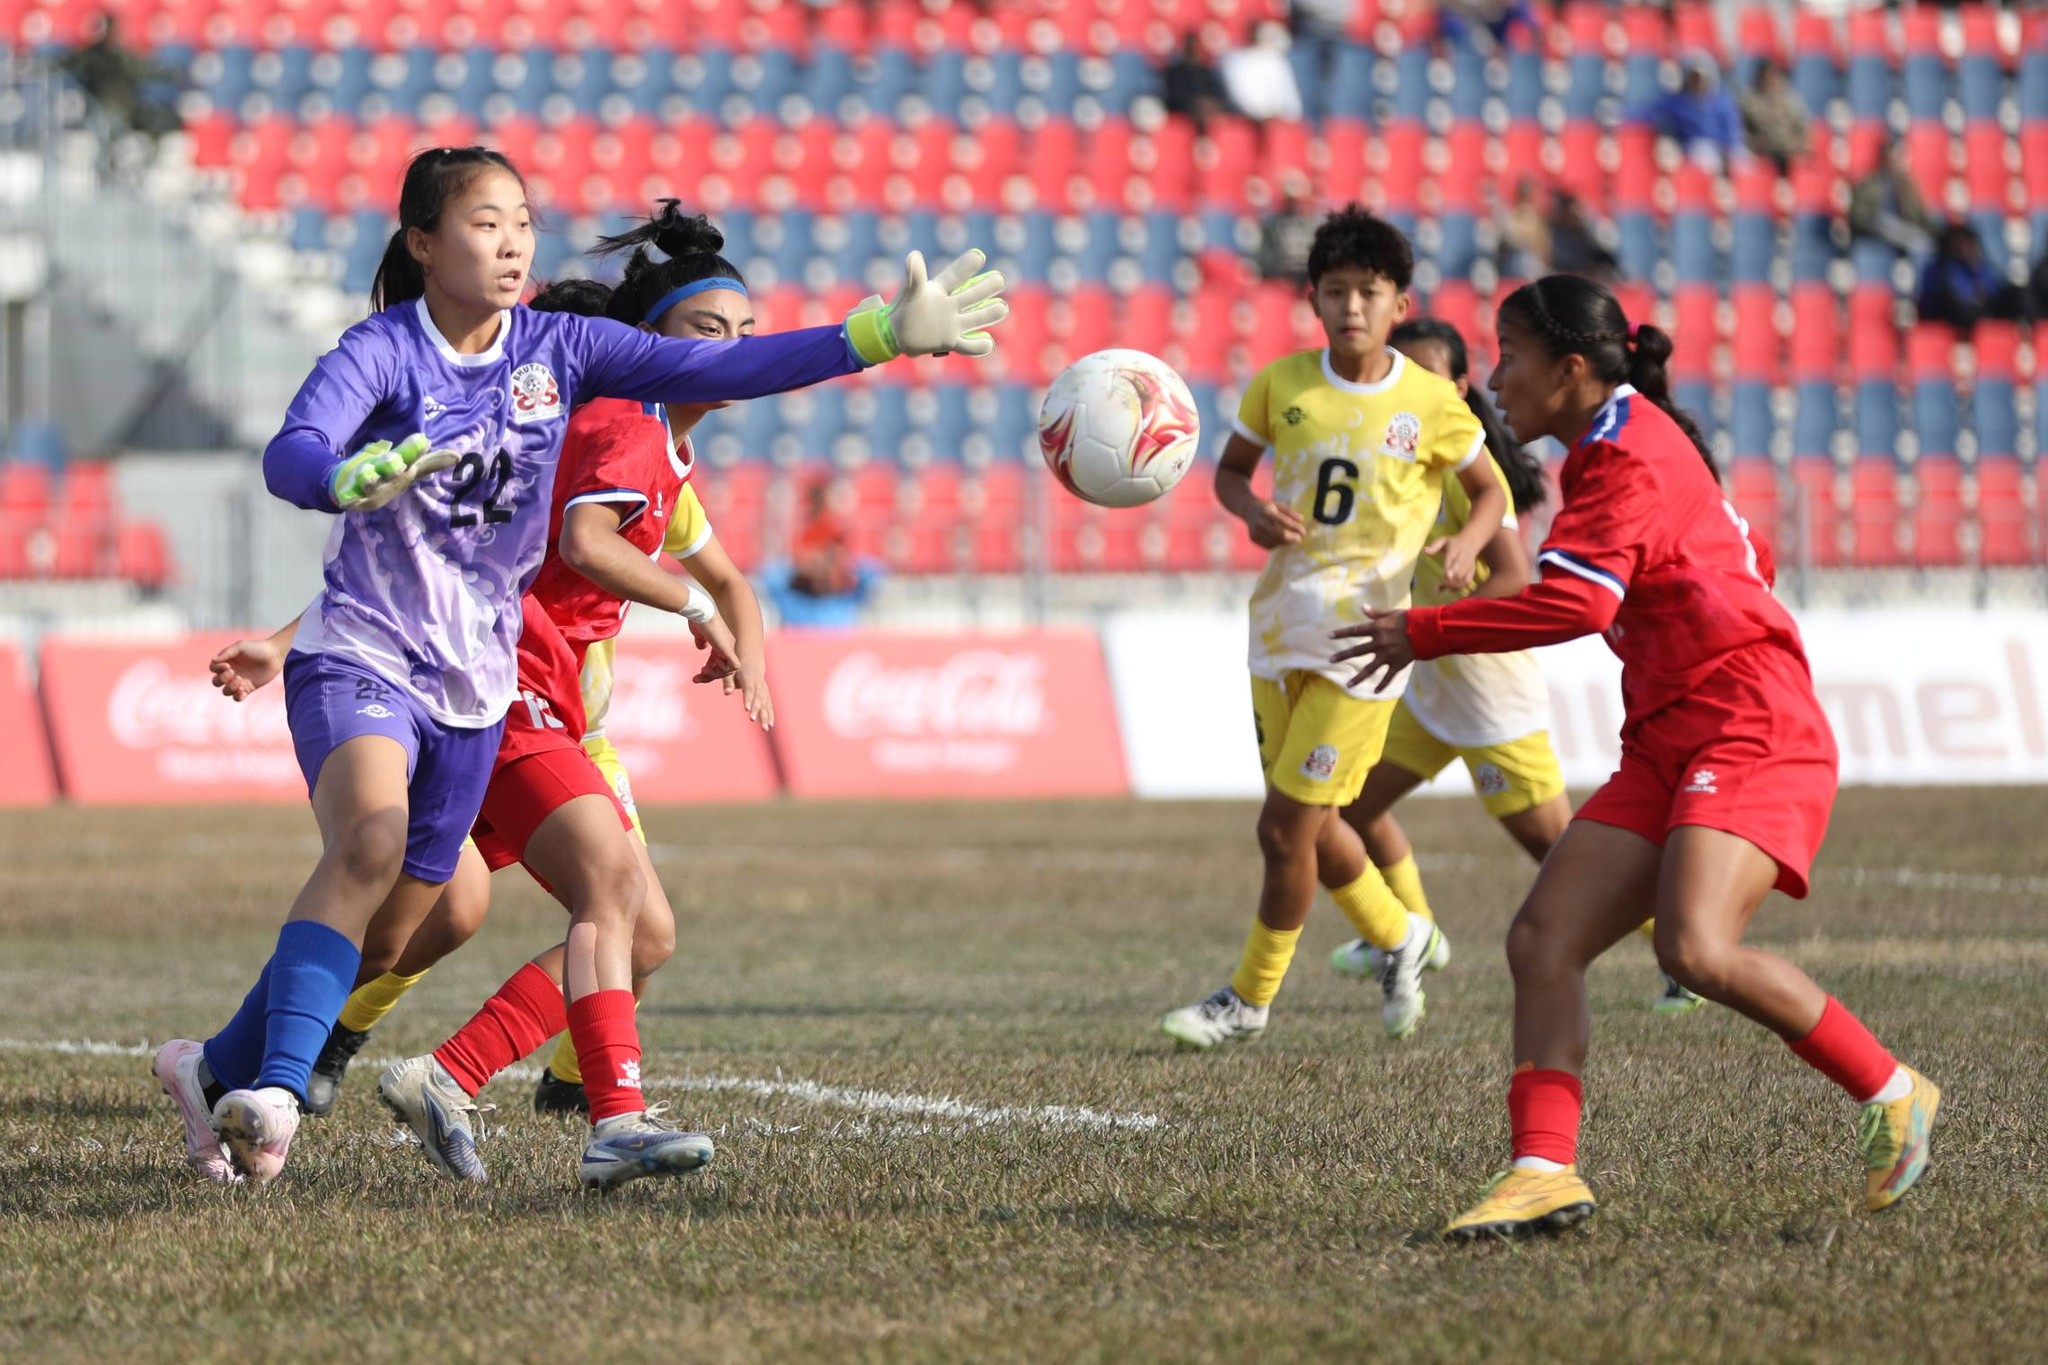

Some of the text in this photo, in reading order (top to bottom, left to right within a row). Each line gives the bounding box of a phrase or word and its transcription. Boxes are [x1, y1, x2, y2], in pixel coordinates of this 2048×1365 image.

[513, 364, 547, 381] BHUTAN
[450, 447, 513, 528] 22
[1313, 458, 1359, 525] 6
